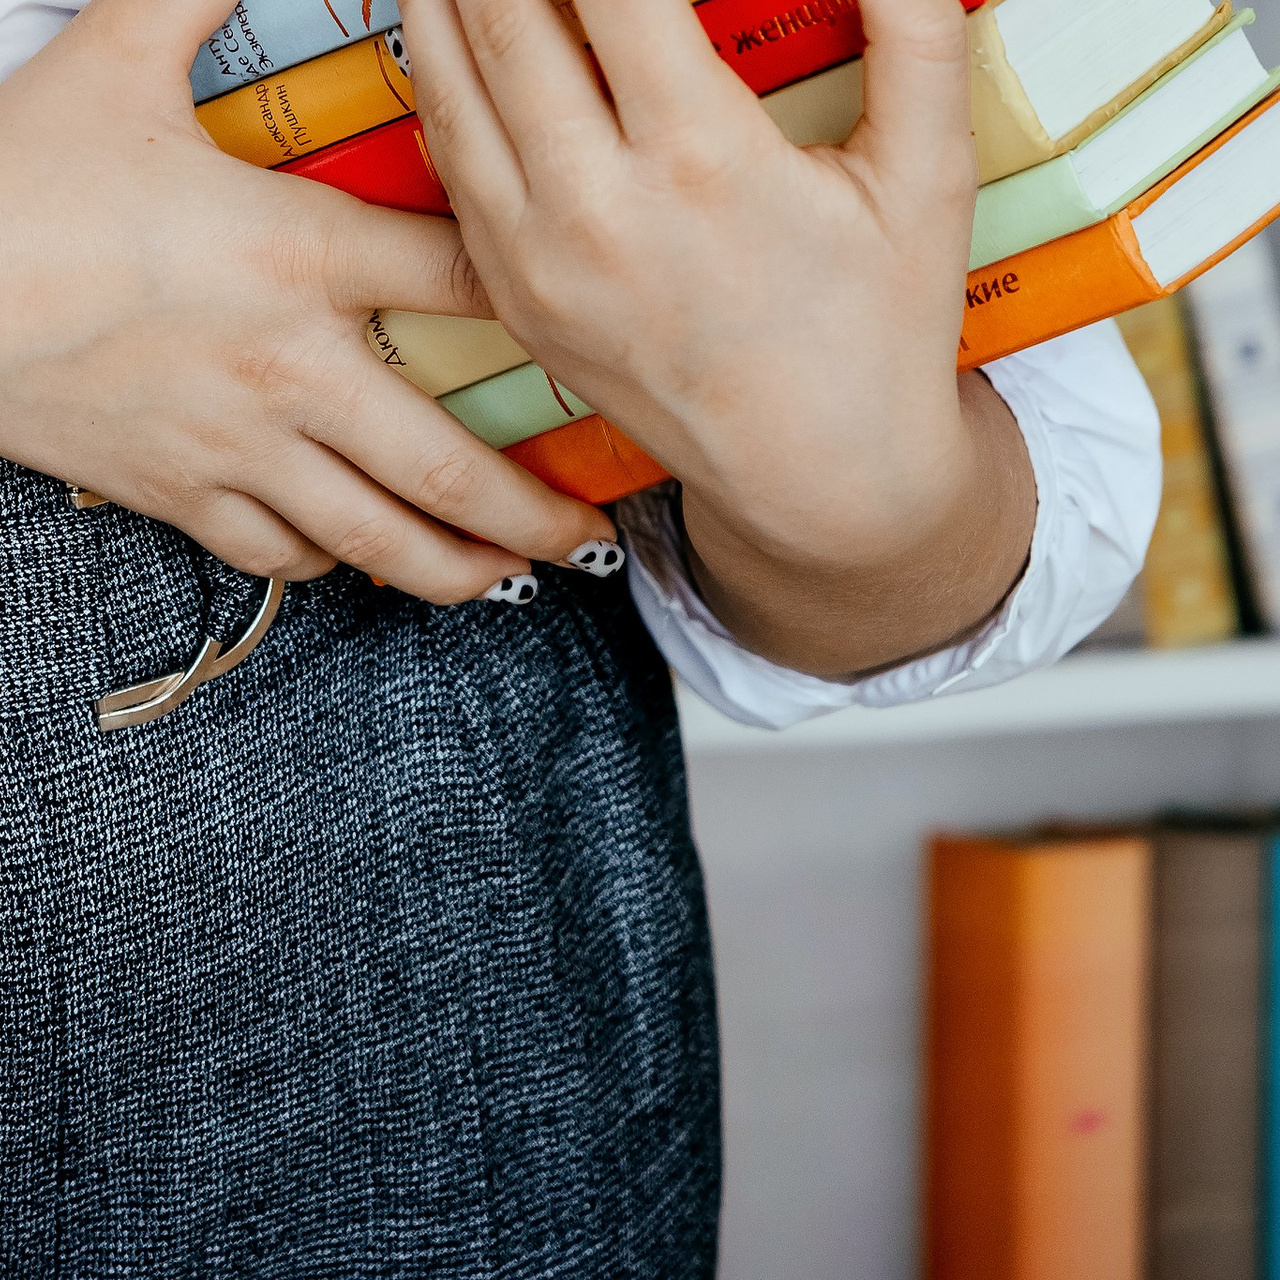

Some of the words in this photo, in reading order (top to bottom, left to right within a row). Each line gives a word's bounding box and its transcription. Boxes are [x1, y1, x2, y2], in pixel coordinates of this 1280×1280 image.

[235, 0, 274, 72] Экзюпер
[238, 56, 260, 75] де
[256, 84, 300, 158] Александр
[276, 84, 313, 146] Пушкин
[368, 308, 407, 366] Дюм
